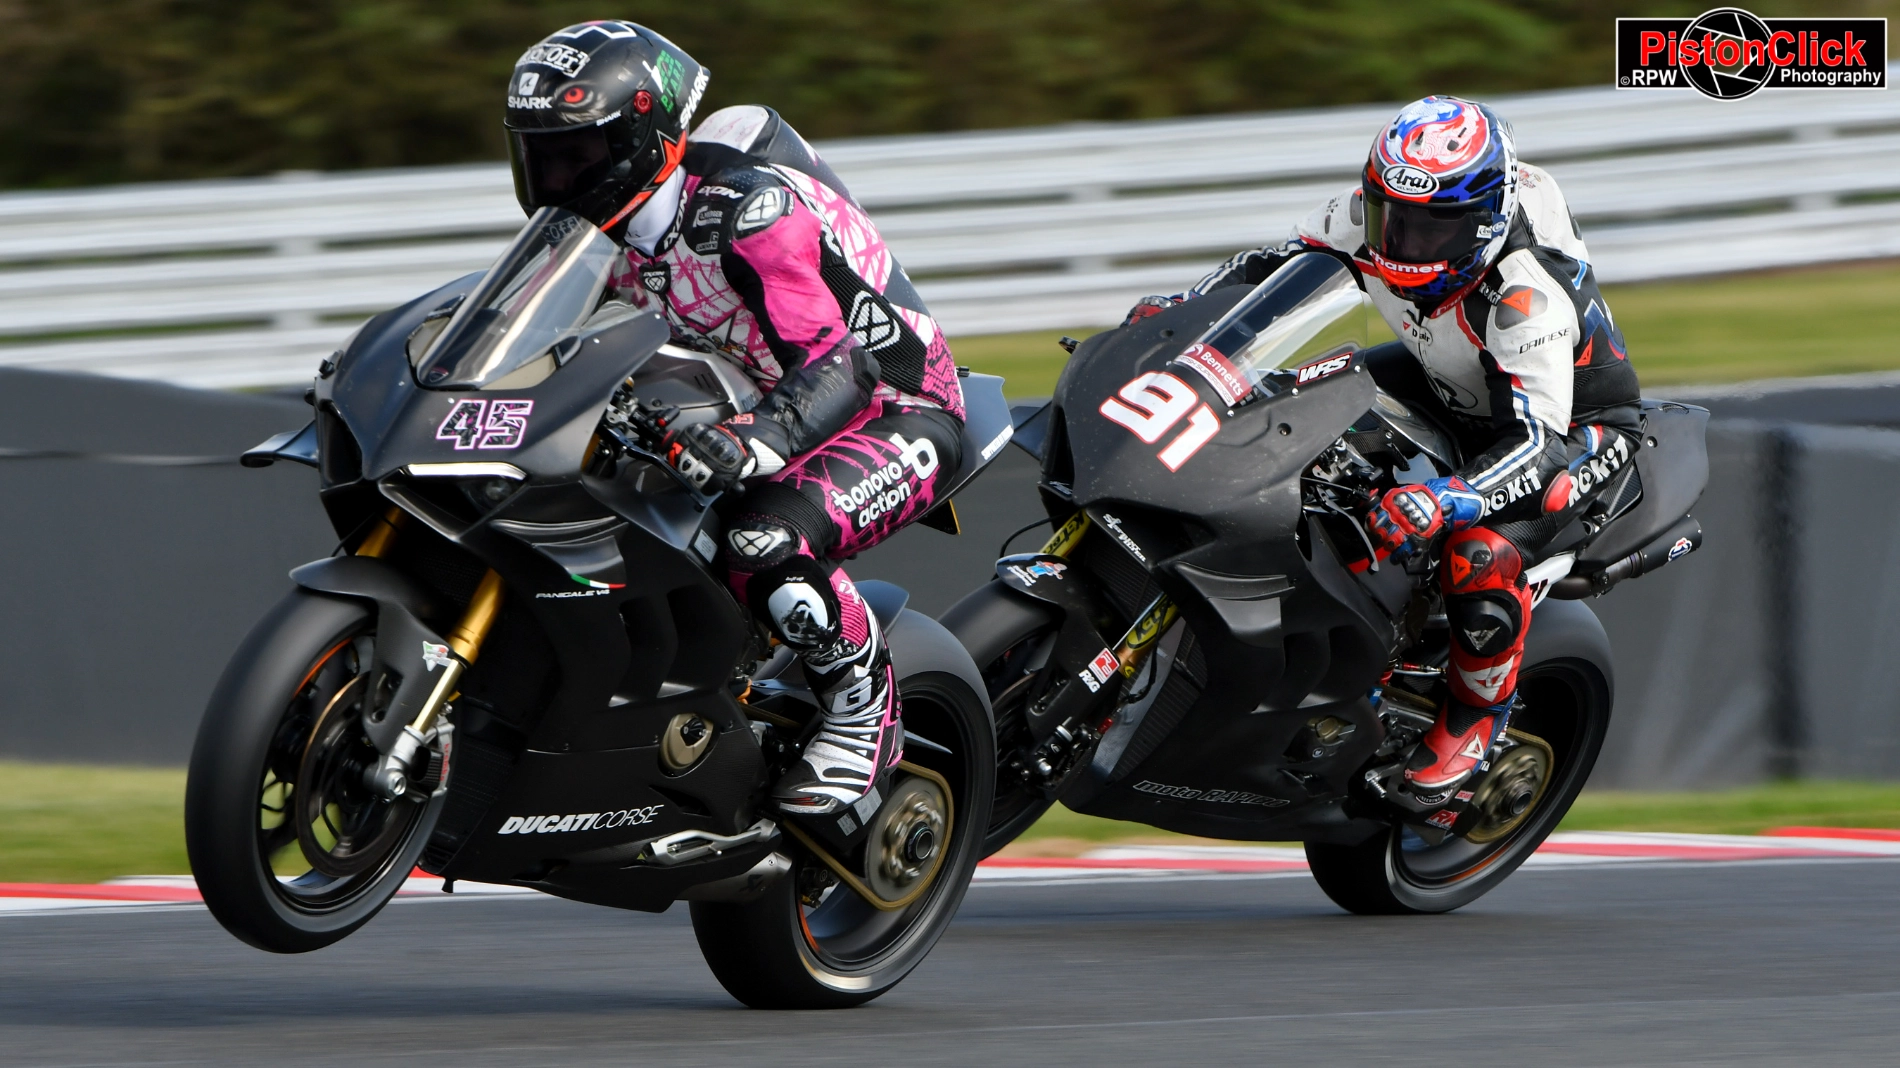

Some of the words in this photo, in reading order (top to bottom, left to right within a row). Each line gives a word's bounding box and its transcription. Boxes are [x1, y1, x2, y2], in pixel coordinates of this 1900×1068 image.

[507, 96, 553, 109] SHARK
[679, 65, 709, 130] SHARK
[1386, 168, 1430, 190] Arai
[663, 189, 688, 249] IXON
[1519, 328, 1570, 354] DAINESE
[1200, 350, 1244, 396] Bennetts
[1299, 354, 1350, 383] WRS
[436, 399, 534, 450] 45
[1099, 371, 1221, 473] 91
[831, 461, 902, 512] bonovo
[858, 481, 911, 528] action
[535, 590, 595, 598] PANIGALE
[1133, 780, 1202, 799] moto
